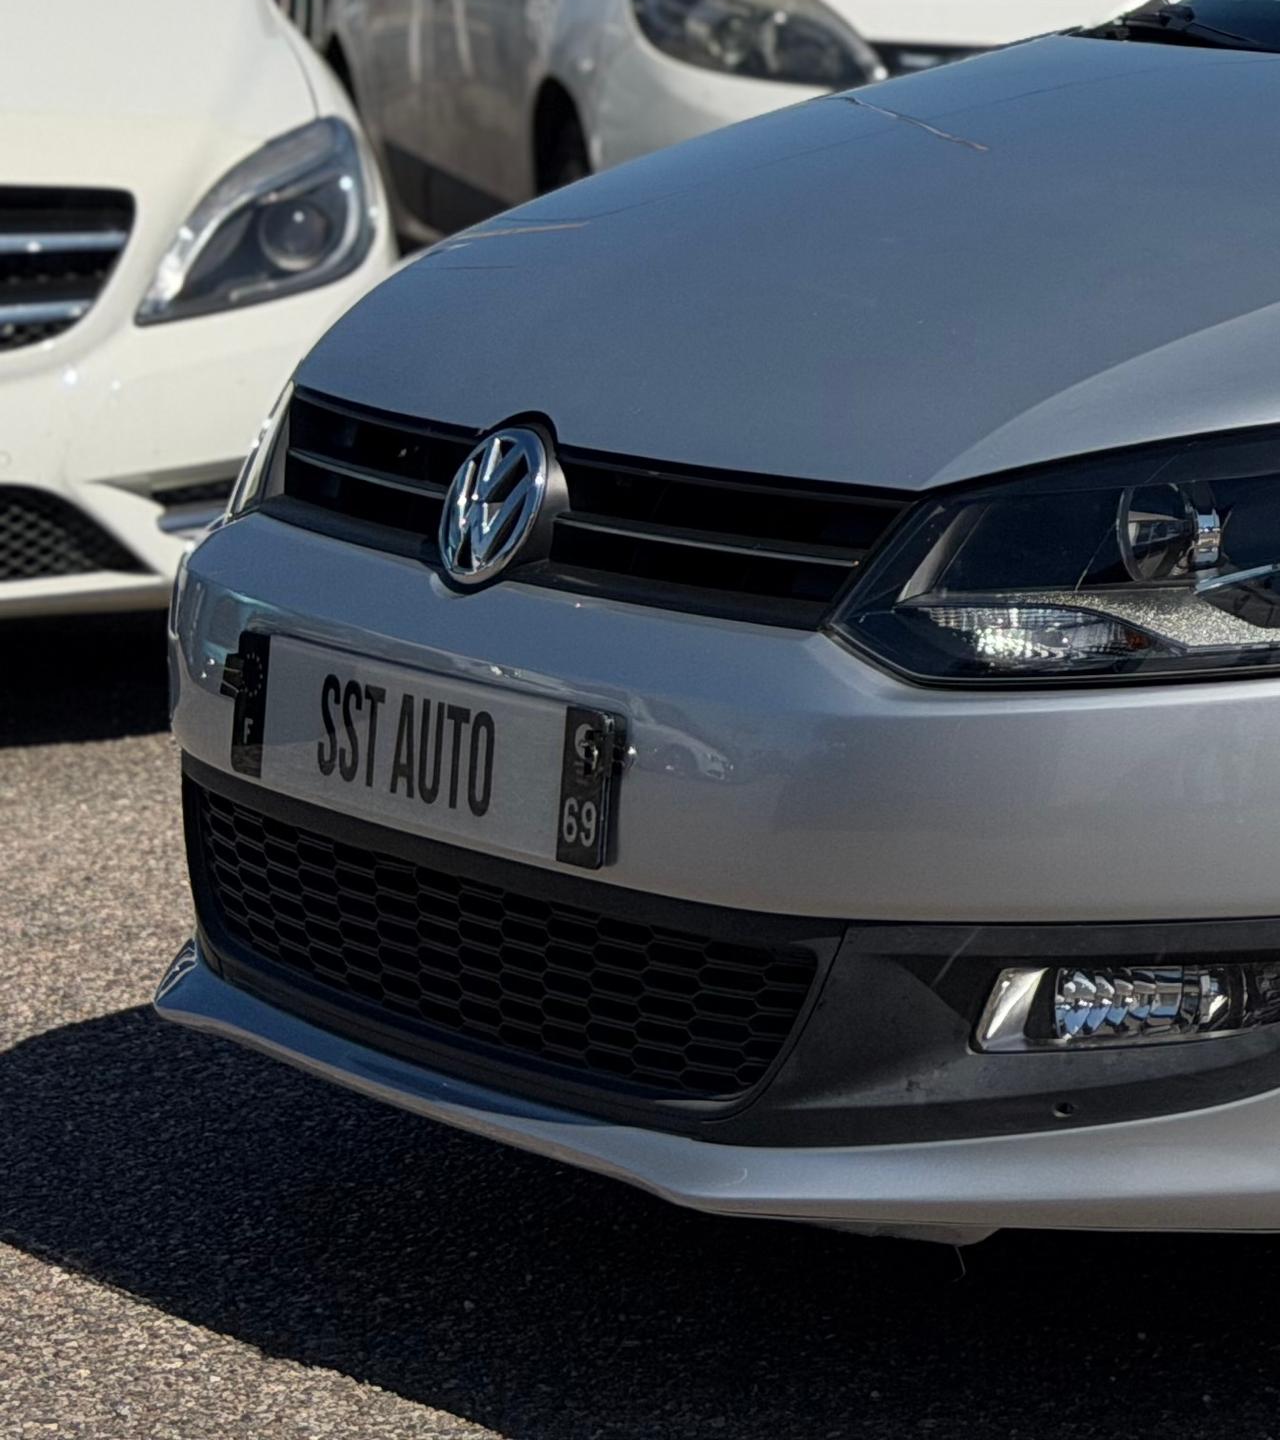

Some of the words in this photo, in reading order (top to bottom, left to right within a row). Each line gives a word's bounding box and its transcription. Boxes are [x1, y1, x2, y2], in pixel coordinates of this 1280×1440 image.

[242, 717, 254, 745] F
[317, 673, 387, 788] SST
[389, 693, 496, 817] AUTO
[562, 796, 598, 848] 69
